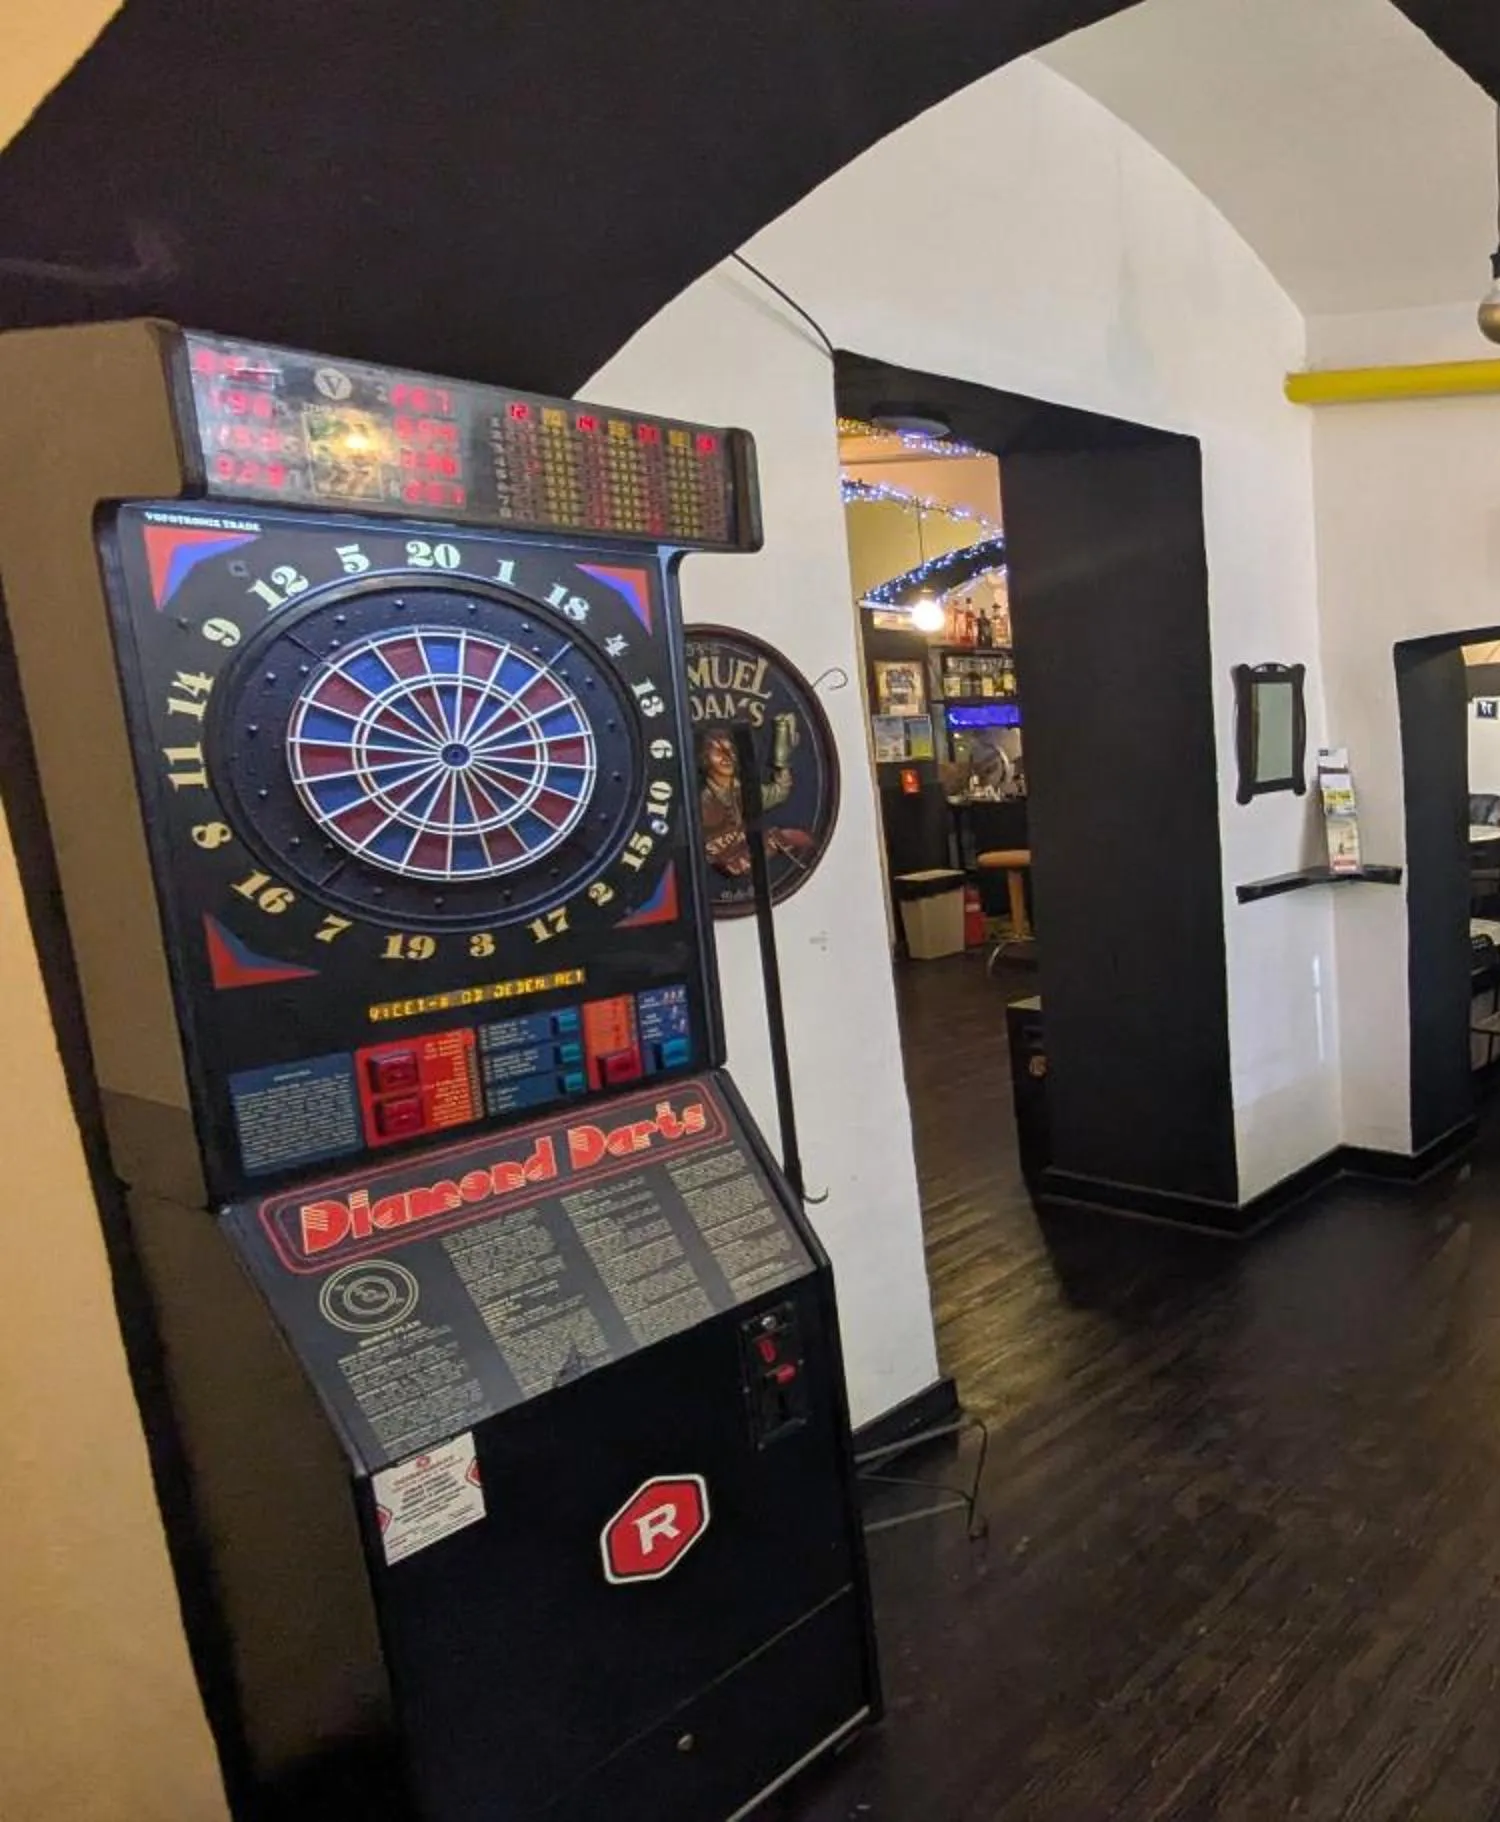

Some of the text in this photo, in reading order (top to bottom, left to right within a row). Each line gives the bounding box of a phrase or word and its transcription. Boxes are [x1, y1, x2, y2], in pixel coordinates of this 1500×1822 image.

[335, 543, 371, 574] 5
[405, 540, 461, 570] 20
[495, 559, 517, 586] 1
[245, 565, 309, 612] 12
[543, 582, 591, 621] 18
[604, 633, 630, 657] 4
[166, 670, 216, 721] 14
[687, 655, 772, 699] MUEL
[631, 677, 665, 717] 13
[161, 741, 210, 792] 11
[647, 780, 673, 817] 10
[191, 821, 233, 849] 8
[620, 832, 653, 872] 15
[229, 869, 296, 914] 16
[588, 882, 615, 906] 2
[314, 912, 353, 944] 7
[527, 906, 571, 944] 17
[380, 933, 437, 960] 19
[468, 932, 496, 958] 3
[301, 1136, 558, 1255] Diamond
[567, 1101, 707, 1170] Darts
[631, 1503, 681, 1555] R
